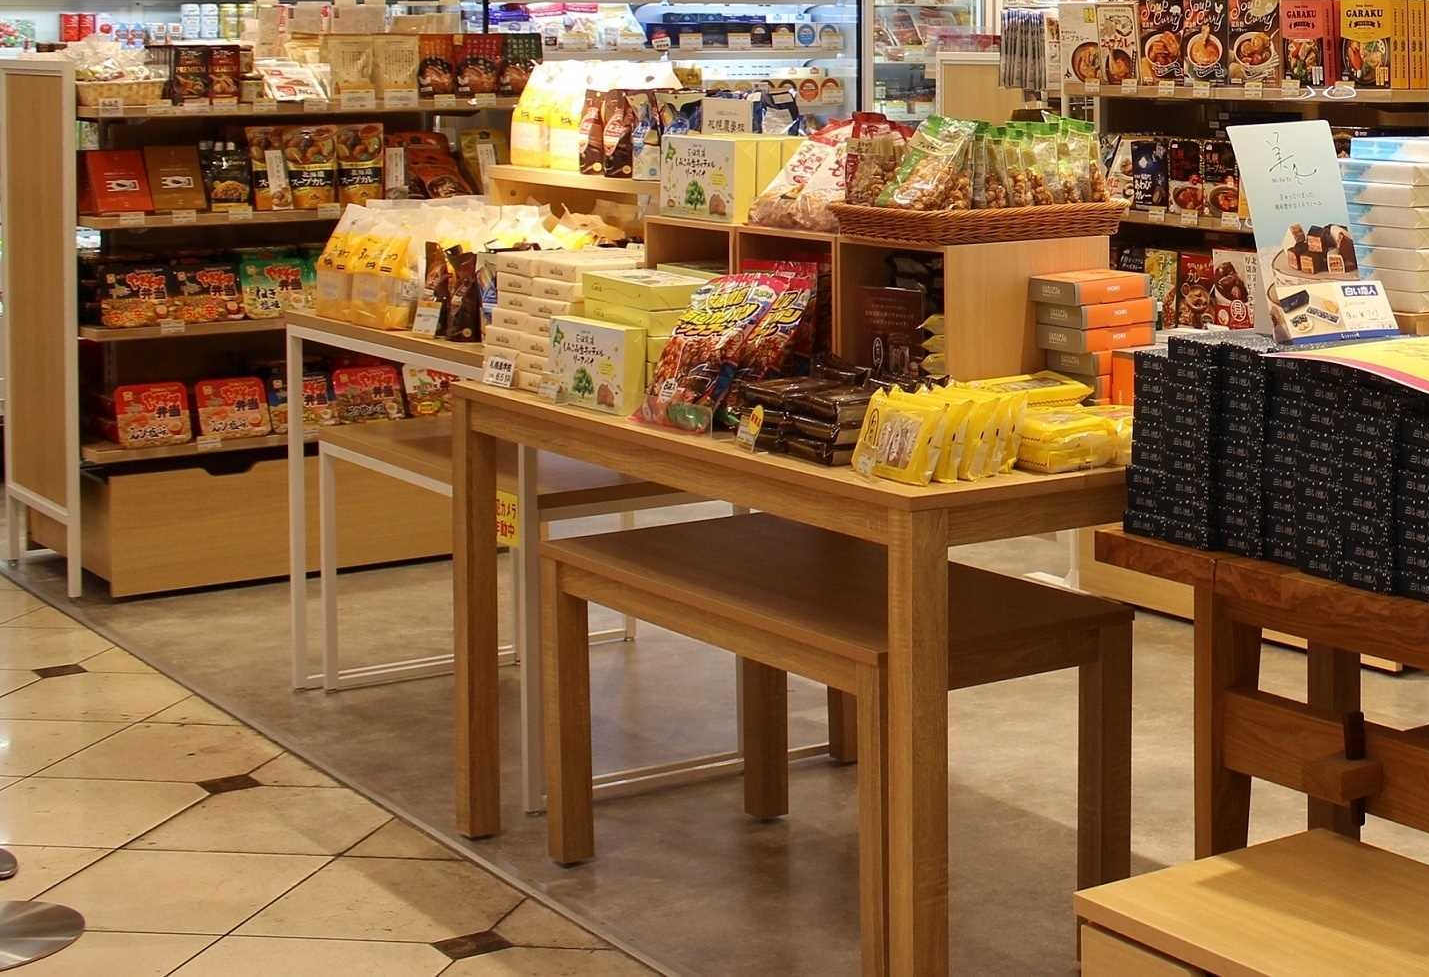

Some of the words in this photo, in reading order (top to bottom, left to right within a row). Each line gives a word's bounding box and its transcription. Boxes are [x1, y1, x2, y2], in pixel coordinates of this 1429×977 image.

[1287, 10, 1317, 18] GARAKU
[1346, 9, 1384, 18] GARAKU
[290, 177, 332, 186] スープカレー
[341, 176, 379, 185] スープカレー
[140, 287, 167, 300] 弁当
[211, 284, 236, 298] 弁当
[1344, 285, 1377, 296] 白い恋人
[235, 398, 260, 411] 弁当
[156, 404, 181, 418] 弁当
